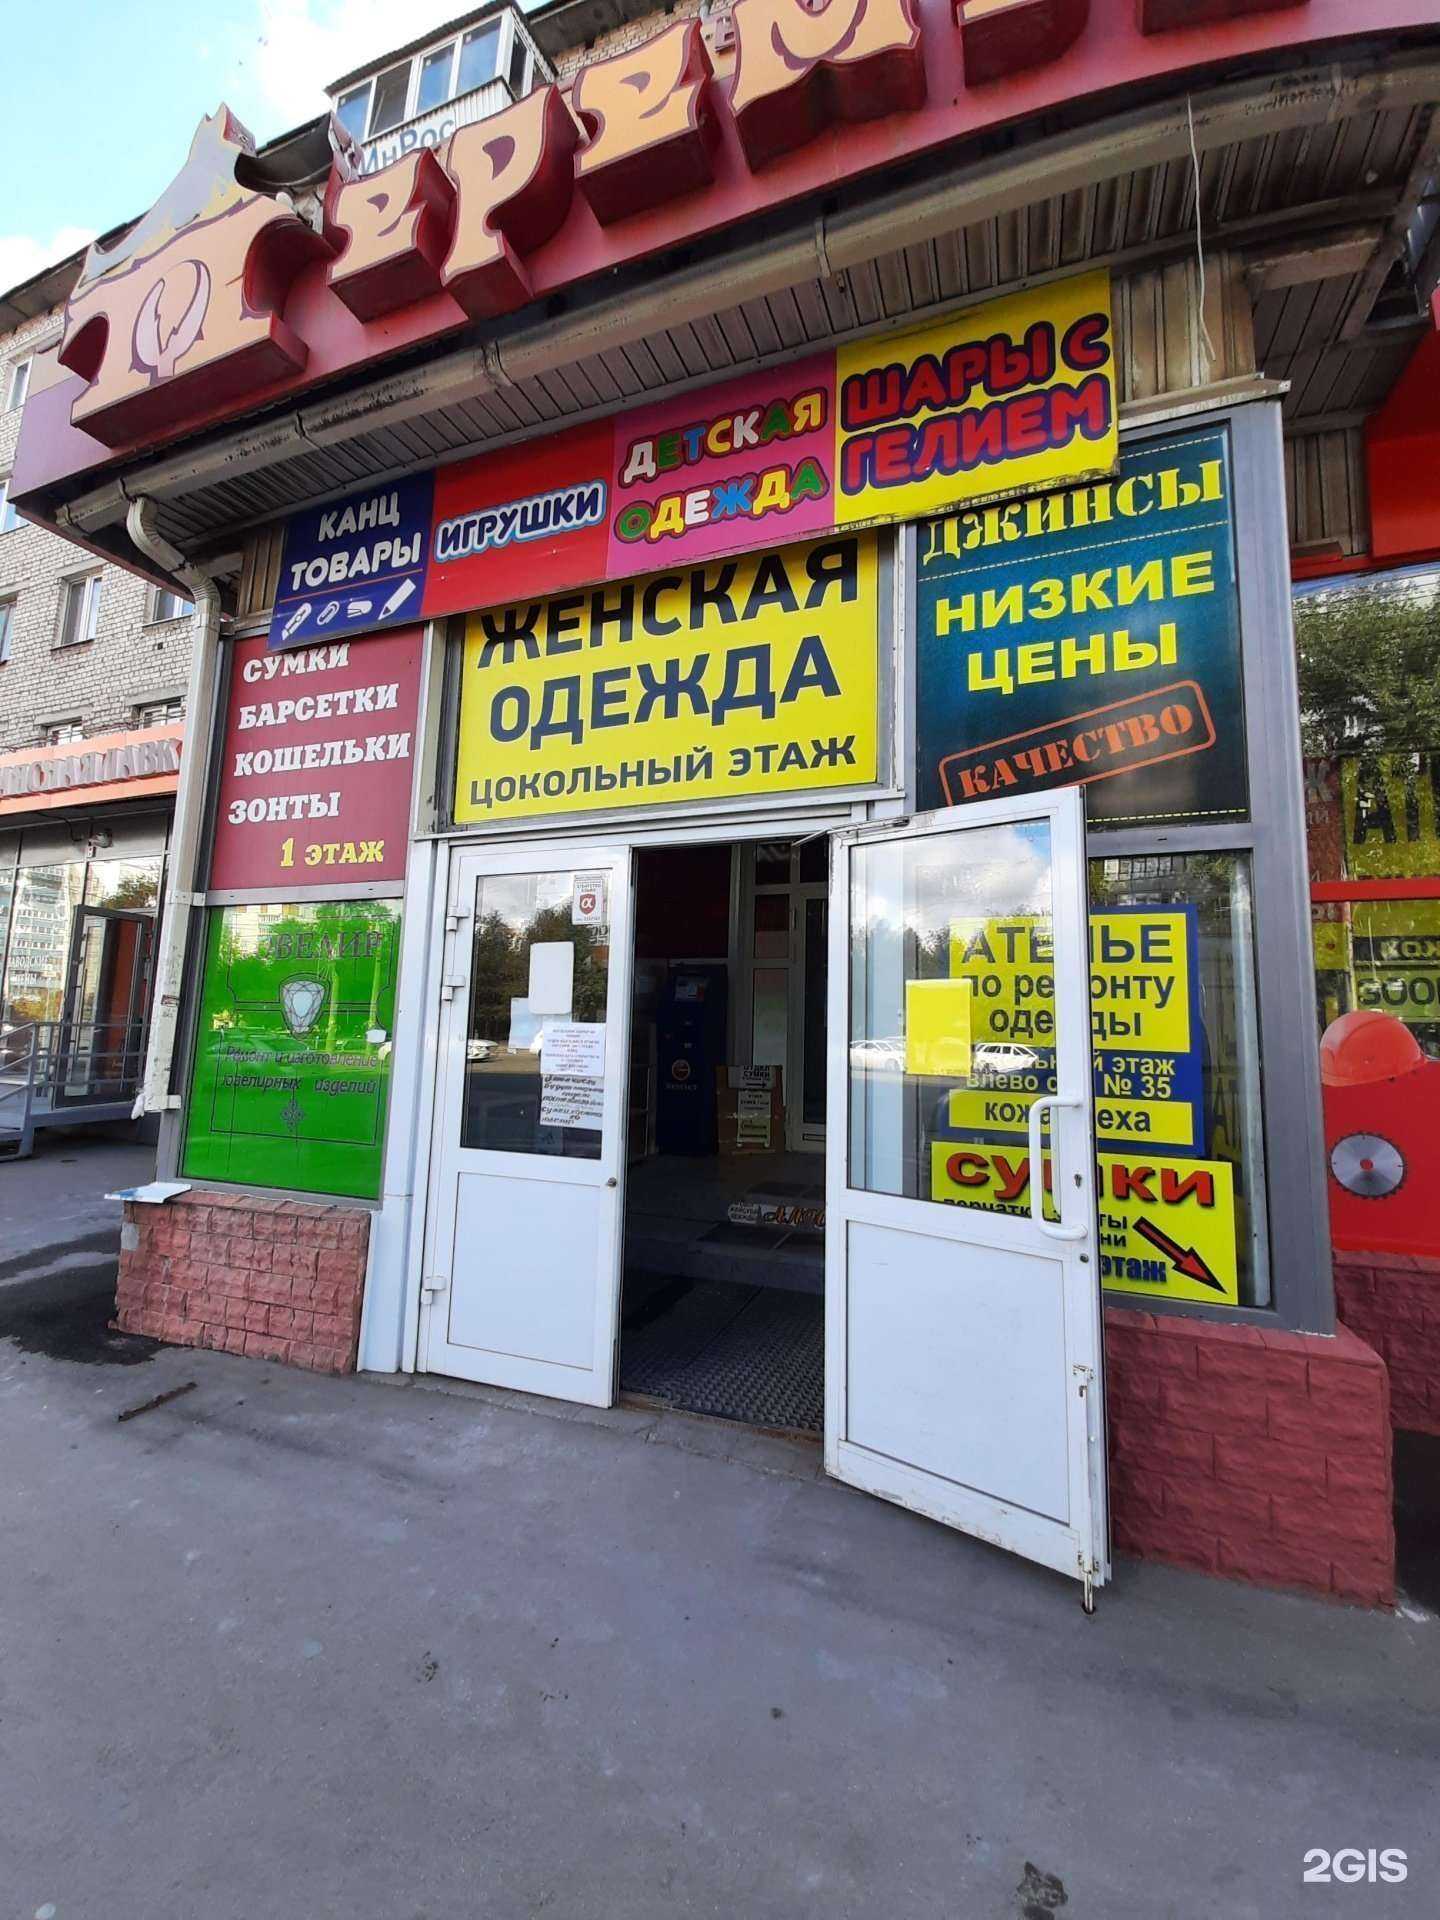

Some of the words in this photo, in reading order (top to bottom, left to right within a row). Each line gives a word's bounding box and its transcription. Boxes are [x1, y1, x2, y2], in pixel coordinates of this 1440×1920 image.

[841, 321, 1055, 432] ШАРЫ
[1062, 313, 1110, 370] С
[619, 389, 827, 487] ДЕТСКАЯ
[841, 373, 1111, 496] ГЕЛИЕМ
[318, 491, 401, 543] КАНЦ
[436, 480, 607, 563] ИГРУШКИ
[615, 458, 828, 543] ОДЕЖДА
[922, 459, 1223, 566] ДЖИНСЫ
[291, 532, 421, 591] ТОВАРЫ
[478, 537, 858, 669] ЖЕНСКАЯ
[935, 551, 1215, 637] НИЗКИЕ
[243, 643, 350, 683] СУМКИ
[968, 623, 1177, 695] ЦЕНЫ
[238, 684, 399, 729] БАРСЕТКИ
[490, 635, 841, 750] ОДЕЖДА
[233, 733, 410, 777] КОШЕЛЬКИ
[470, 746, 713, 808] ЦОКОЛЬНЫЙ
[728, 734, 856, 776] ЭТАЖ
[958, 703, 1193, 799] КАЧЕСТВО
[228, 792, 341, 824] ЗОНТЫ
[280, 837, 294, 867] 1
[305, 840, 385, 866] ЭТАЖ
[961, 924, 1173, 964] АТЕЬЕ
[1015, 974, 1175, 1009] реонту
[989, 1009, 1142, 1041] одеды
[1112, 1057, 1175, 1076] этаж
[1141, 1076, 1171, 1098] 35
[1098, 1108, 1151, 1132] еха
[946, 1152, 1215, 1207] суки
